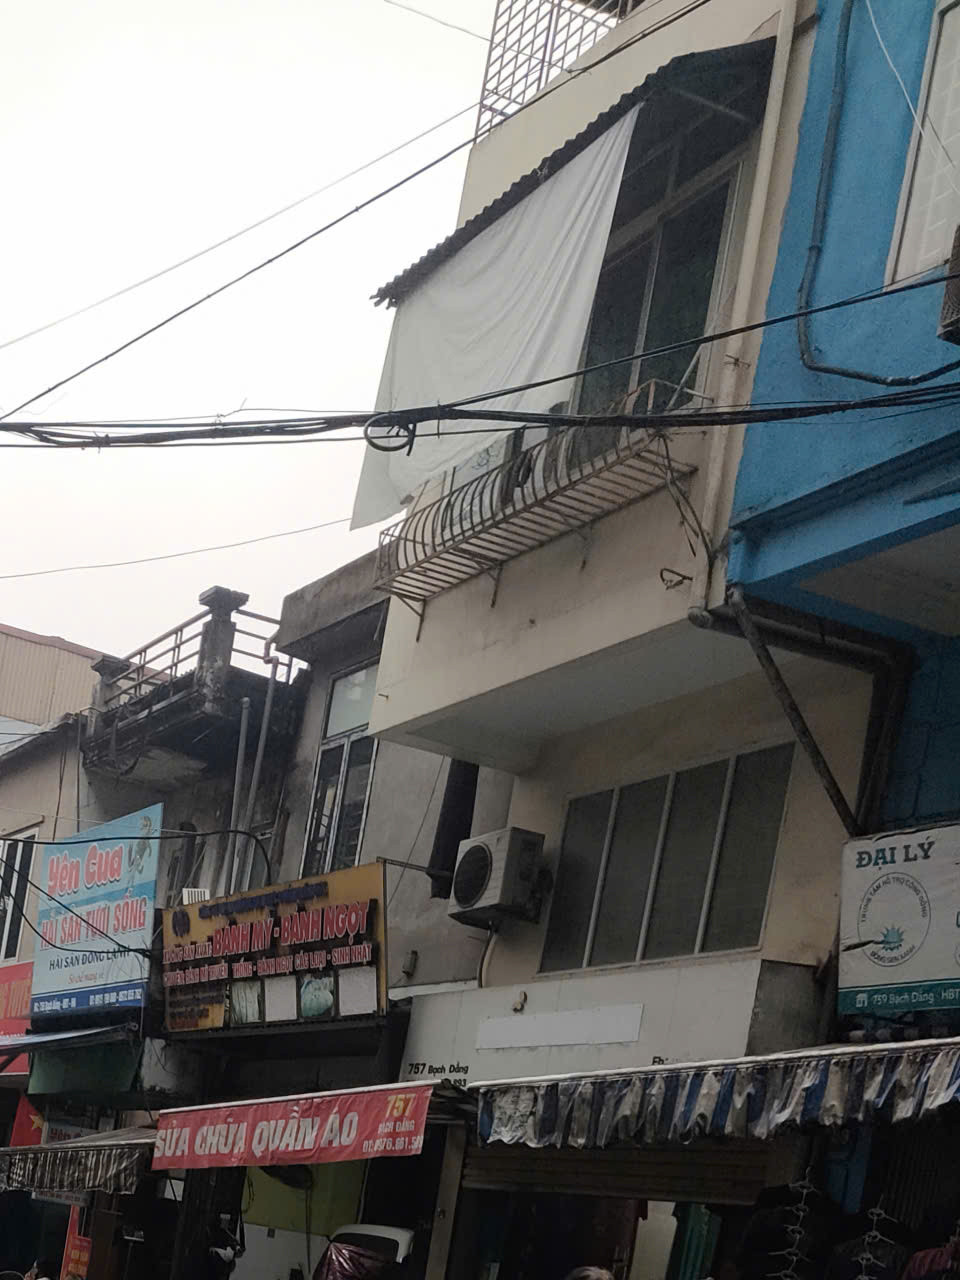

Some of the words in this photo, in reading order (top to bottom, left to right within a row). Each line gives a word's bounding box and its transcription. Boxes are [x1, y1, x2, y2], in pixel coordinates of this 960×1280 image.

[47, 850, 81, 899] Yên
[84, 843, 124, 888] Cua
[856, 847, 897, 870] ĐẠI
[903, 836, 935, 862] LÝ
[113, 888, 148, 935] SỐNG
[213, 919, 251, 957] BÁNH
[280, 901, 321, 945] BÁNH
[323, 901, 370, 945] NGỌT
[408, 1063, 427, 1075] 757
[427, 1065, 446, 1077] Bạch
[449, 1061, 469, 1075] Đằng
[387, 1093, 416, 1118] 757
[154, 1120, 190, 1158] SỬA
[194, 1117, 247, 1155] CHỮA
[251, 1106, 319, 1159] QUẦN
[320, 1105, 359, 1147] ÁO
